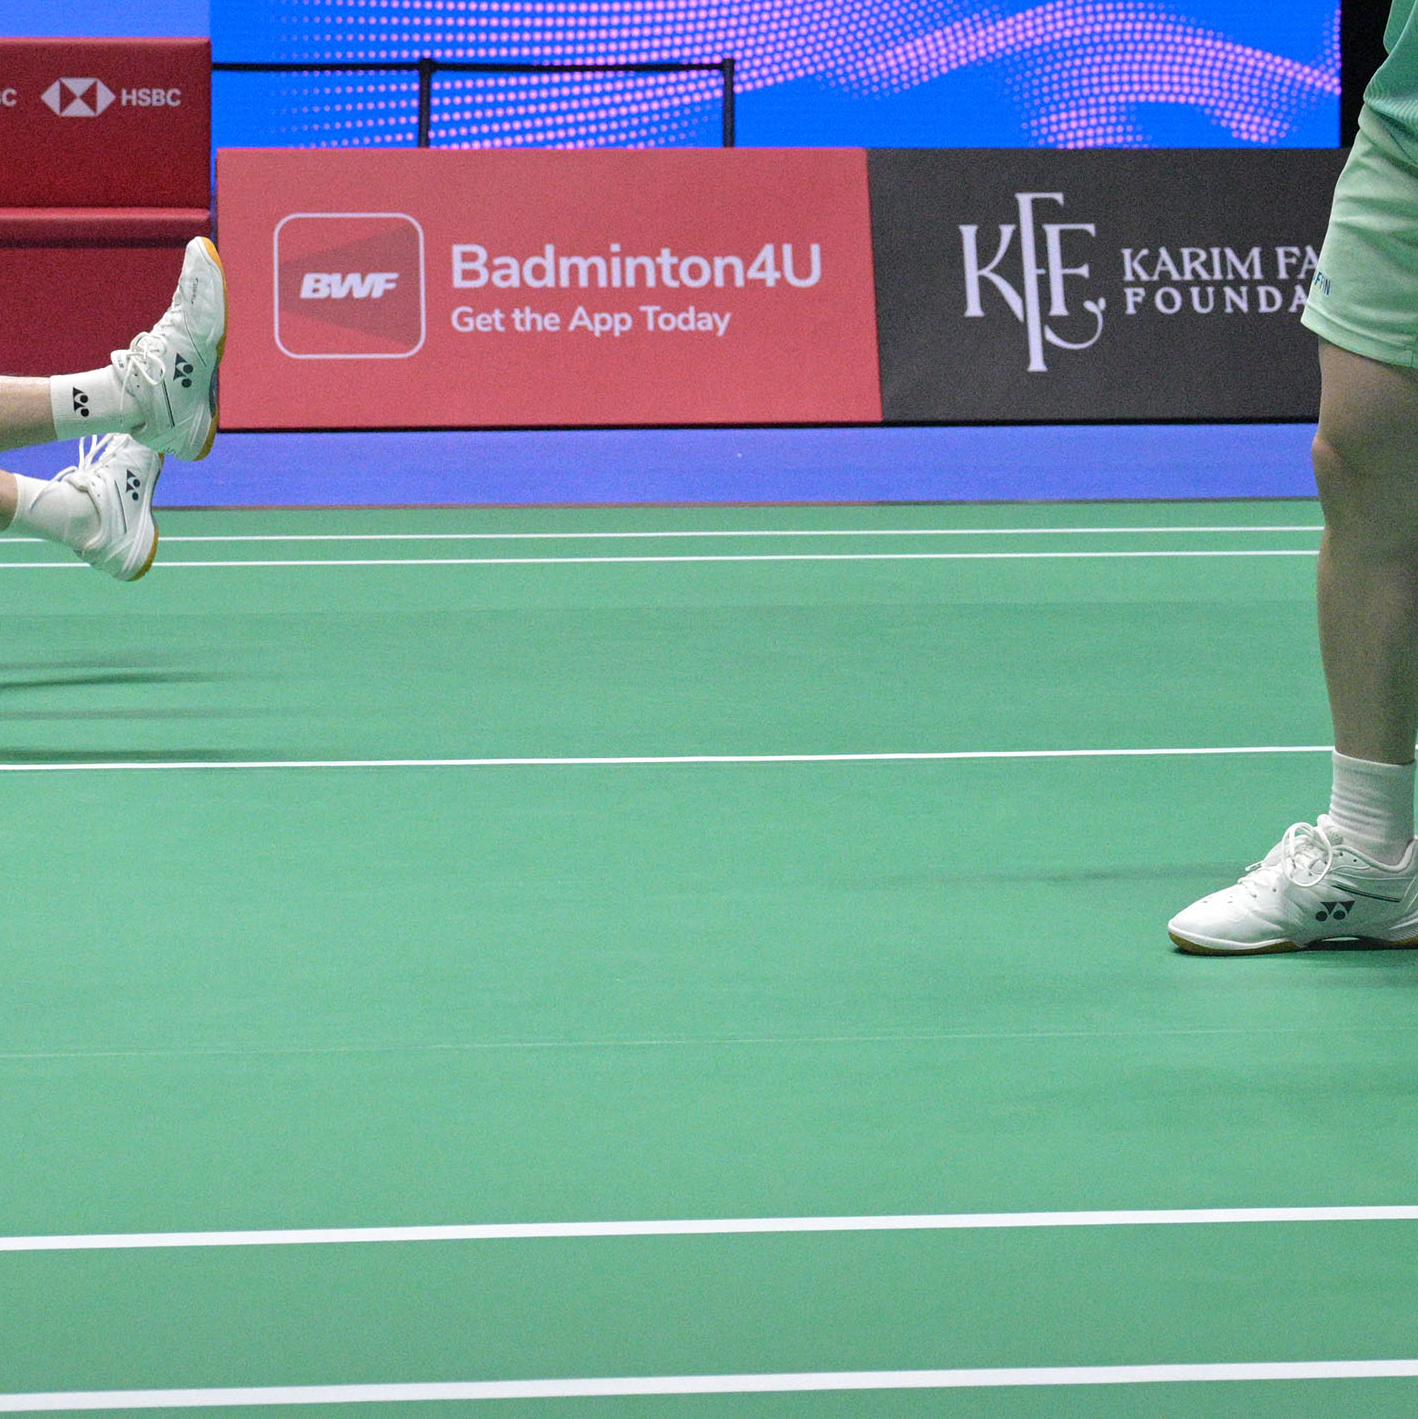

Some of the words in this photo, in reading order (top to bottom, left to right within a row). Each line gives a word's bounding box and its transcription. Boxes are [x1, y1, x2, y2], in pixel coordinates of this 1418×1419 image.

[120, 87, 181, 108] HSBC
[451, 243, 822, 289] Badminton4U
[1121, 246, 1264, 281] KARIM
[299, 272, 400, 299] BWF
[450, 307, 506, 332] Get
[511, 307, 561, 332] the
[568, 306, 633, 337] App
[639, 306, 731, 338] Today
